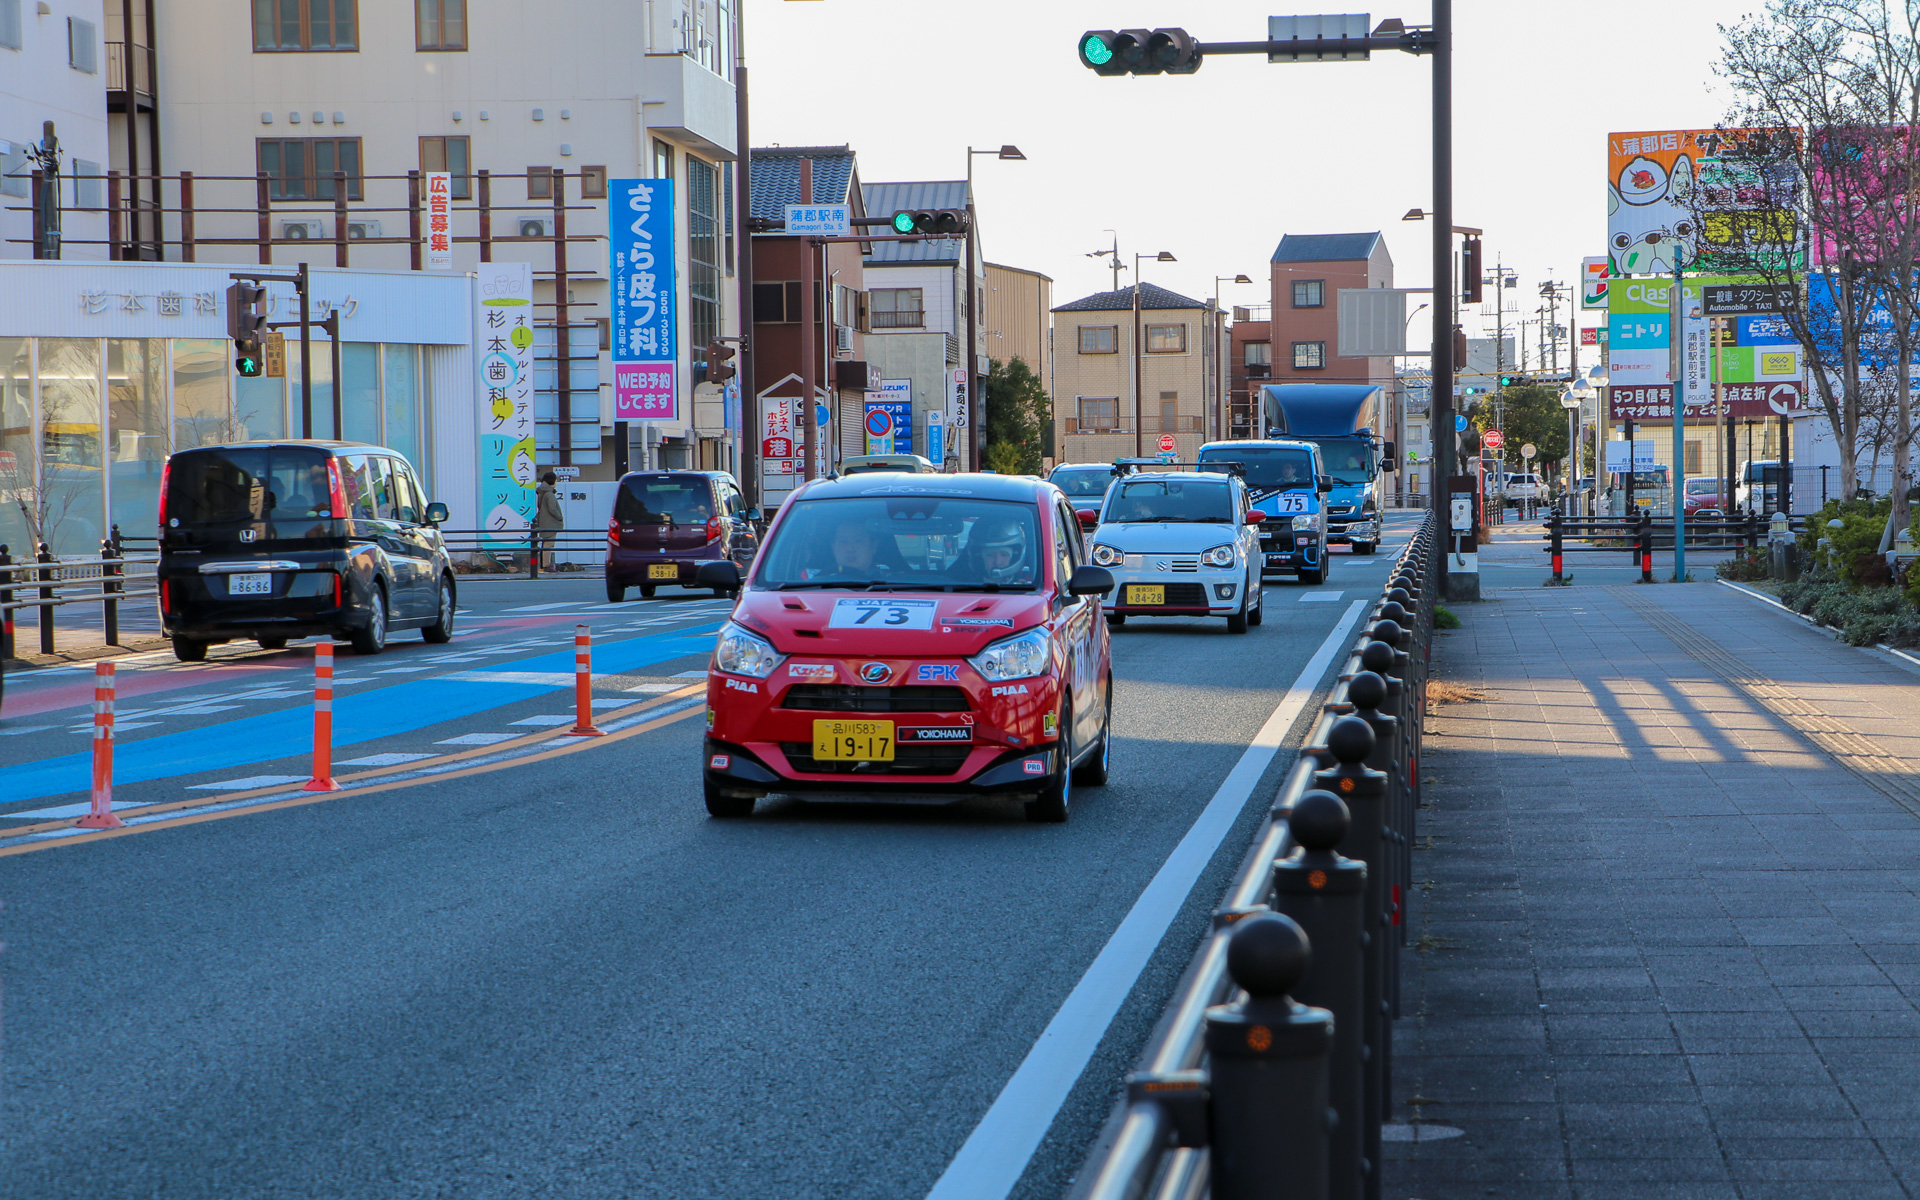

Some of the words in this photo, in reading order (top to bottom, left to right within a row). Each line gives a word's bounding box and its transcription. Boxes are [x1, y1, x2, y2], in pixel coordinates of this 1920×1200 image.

[1622, 134, 1678, 154] 蒲郡店
[430, 176, 449, 252] 広告募集
[791, 209, 844, 222] 蒲郡駅南
[791, 223, 821, 231] Gamagori
[628, 183, 658, 356] さくら皮フ科
[81, 288, 359, 318] 杉本歯科リニック
[1709, 304, 1748, 312] Automobile
[1582, 331, 1596, 342] たばこ
[1620, 323, 1663, 338] ニトリ
[1688, 332, 1698, 390] 蒲郡駅前交番
[618, 372, 671, 389] WEB予約
[618, 393, 671, 410] してます
[1614, 388, 1671, 403] 5つ目信号
[487, 310, 508, 531] 杉本歯科クリニック
[767, 412, 778, 436] ホテル
[779, 401, 789, 433] ビジネス
[515, 314, 531, 546] オーラルメンテナンスステーション
[769, 439, 787, 456] 港
[1283, 498, 1303, 511] 75
[238, 581, 269, 592] 86-86
[1135, 593, 1162, 603] 84-28
[854, 607, 909, 625] 73
[960, 618, 1010, 626] YOKOHAMA
[790, 666, 833, 676] ベストカー
[917, 665, 960, 681] SPK
[725, 678, 758, 693] PIAA
[991, 684, 1029, 697] PIAA
[833, 723, 876, 734] 品川583
[916, 729, 968, 739] YOKOHAMA
[835, 737, 889, 757] 19-17
[1027, 761, 1041, 770] PRO
